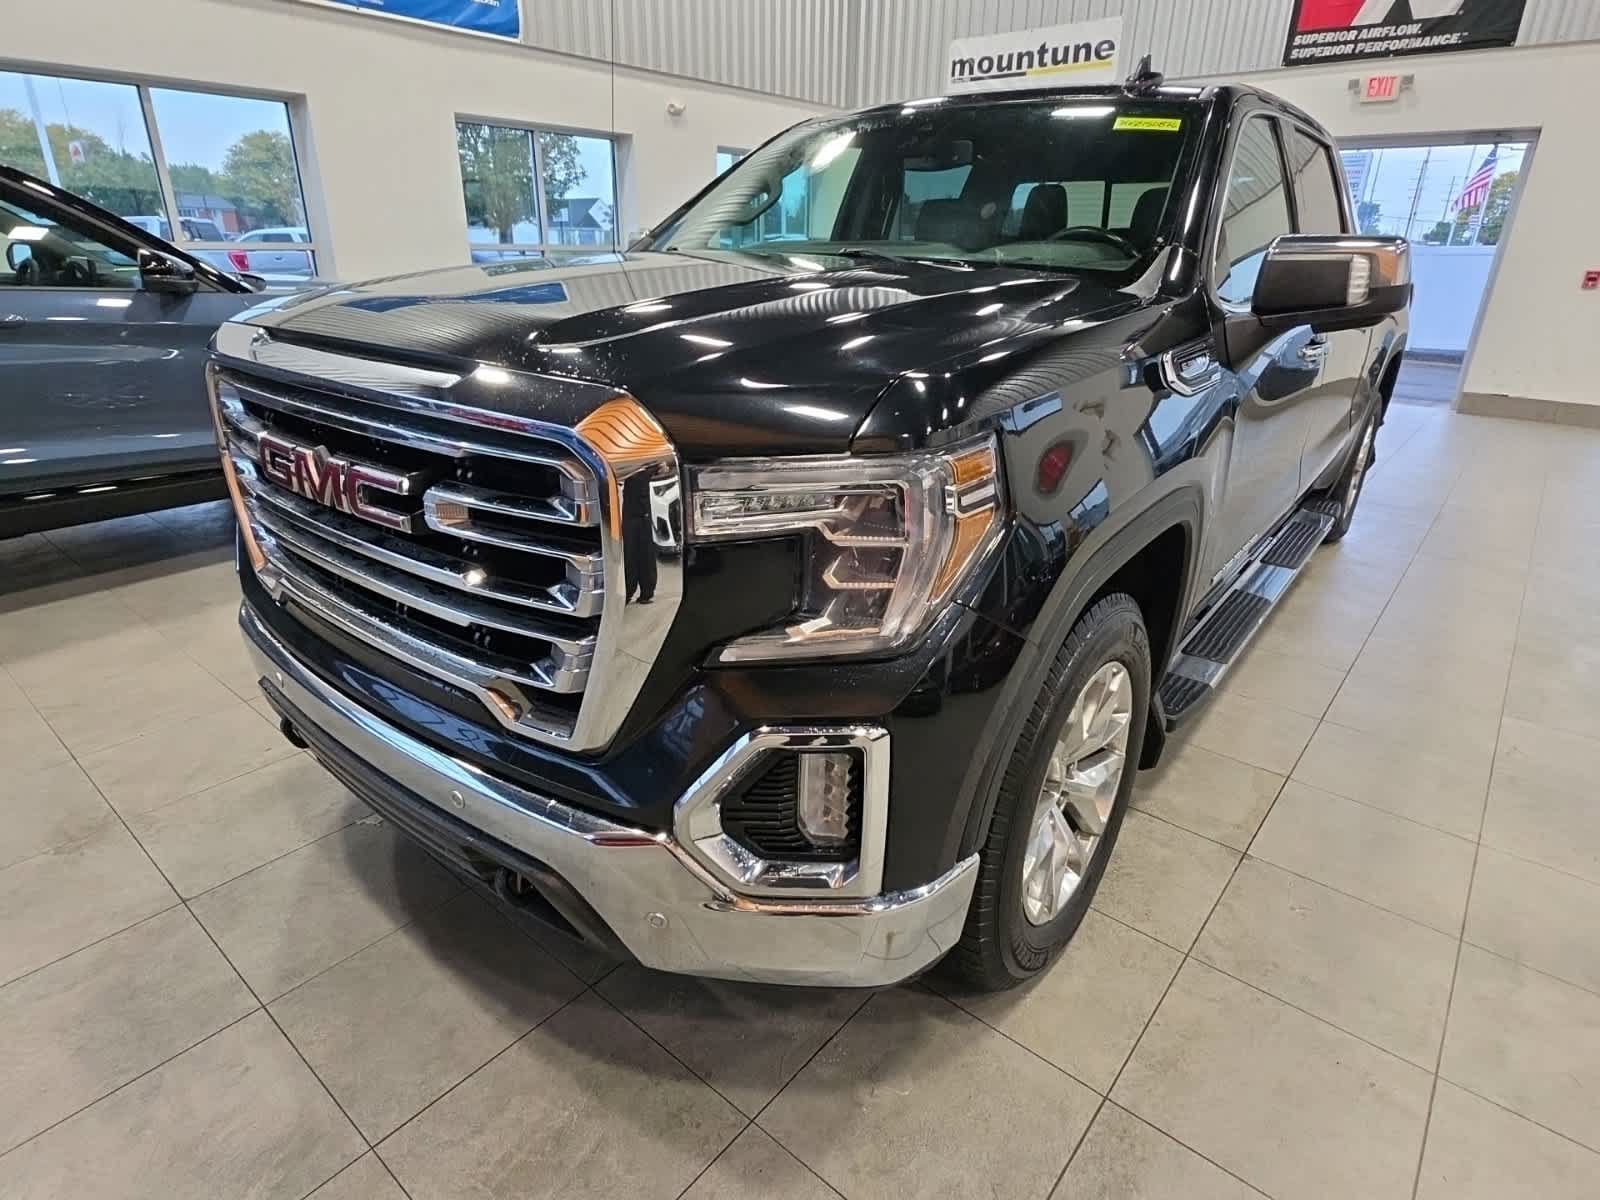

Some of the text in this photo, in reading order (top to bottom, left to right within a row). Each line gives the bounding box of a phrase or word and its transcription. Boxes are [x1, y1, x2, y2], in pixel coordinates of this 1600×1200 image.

[1293, 23, 1422, 46] SUPERIOR AIRFLOW.
[951, 39, 1115, 78] mountune
[1290, 44, 1355, 59] SUPERIOR
[1367, 75, 1398, 97] EXIT
[257, 431, 413, 534] GMC
